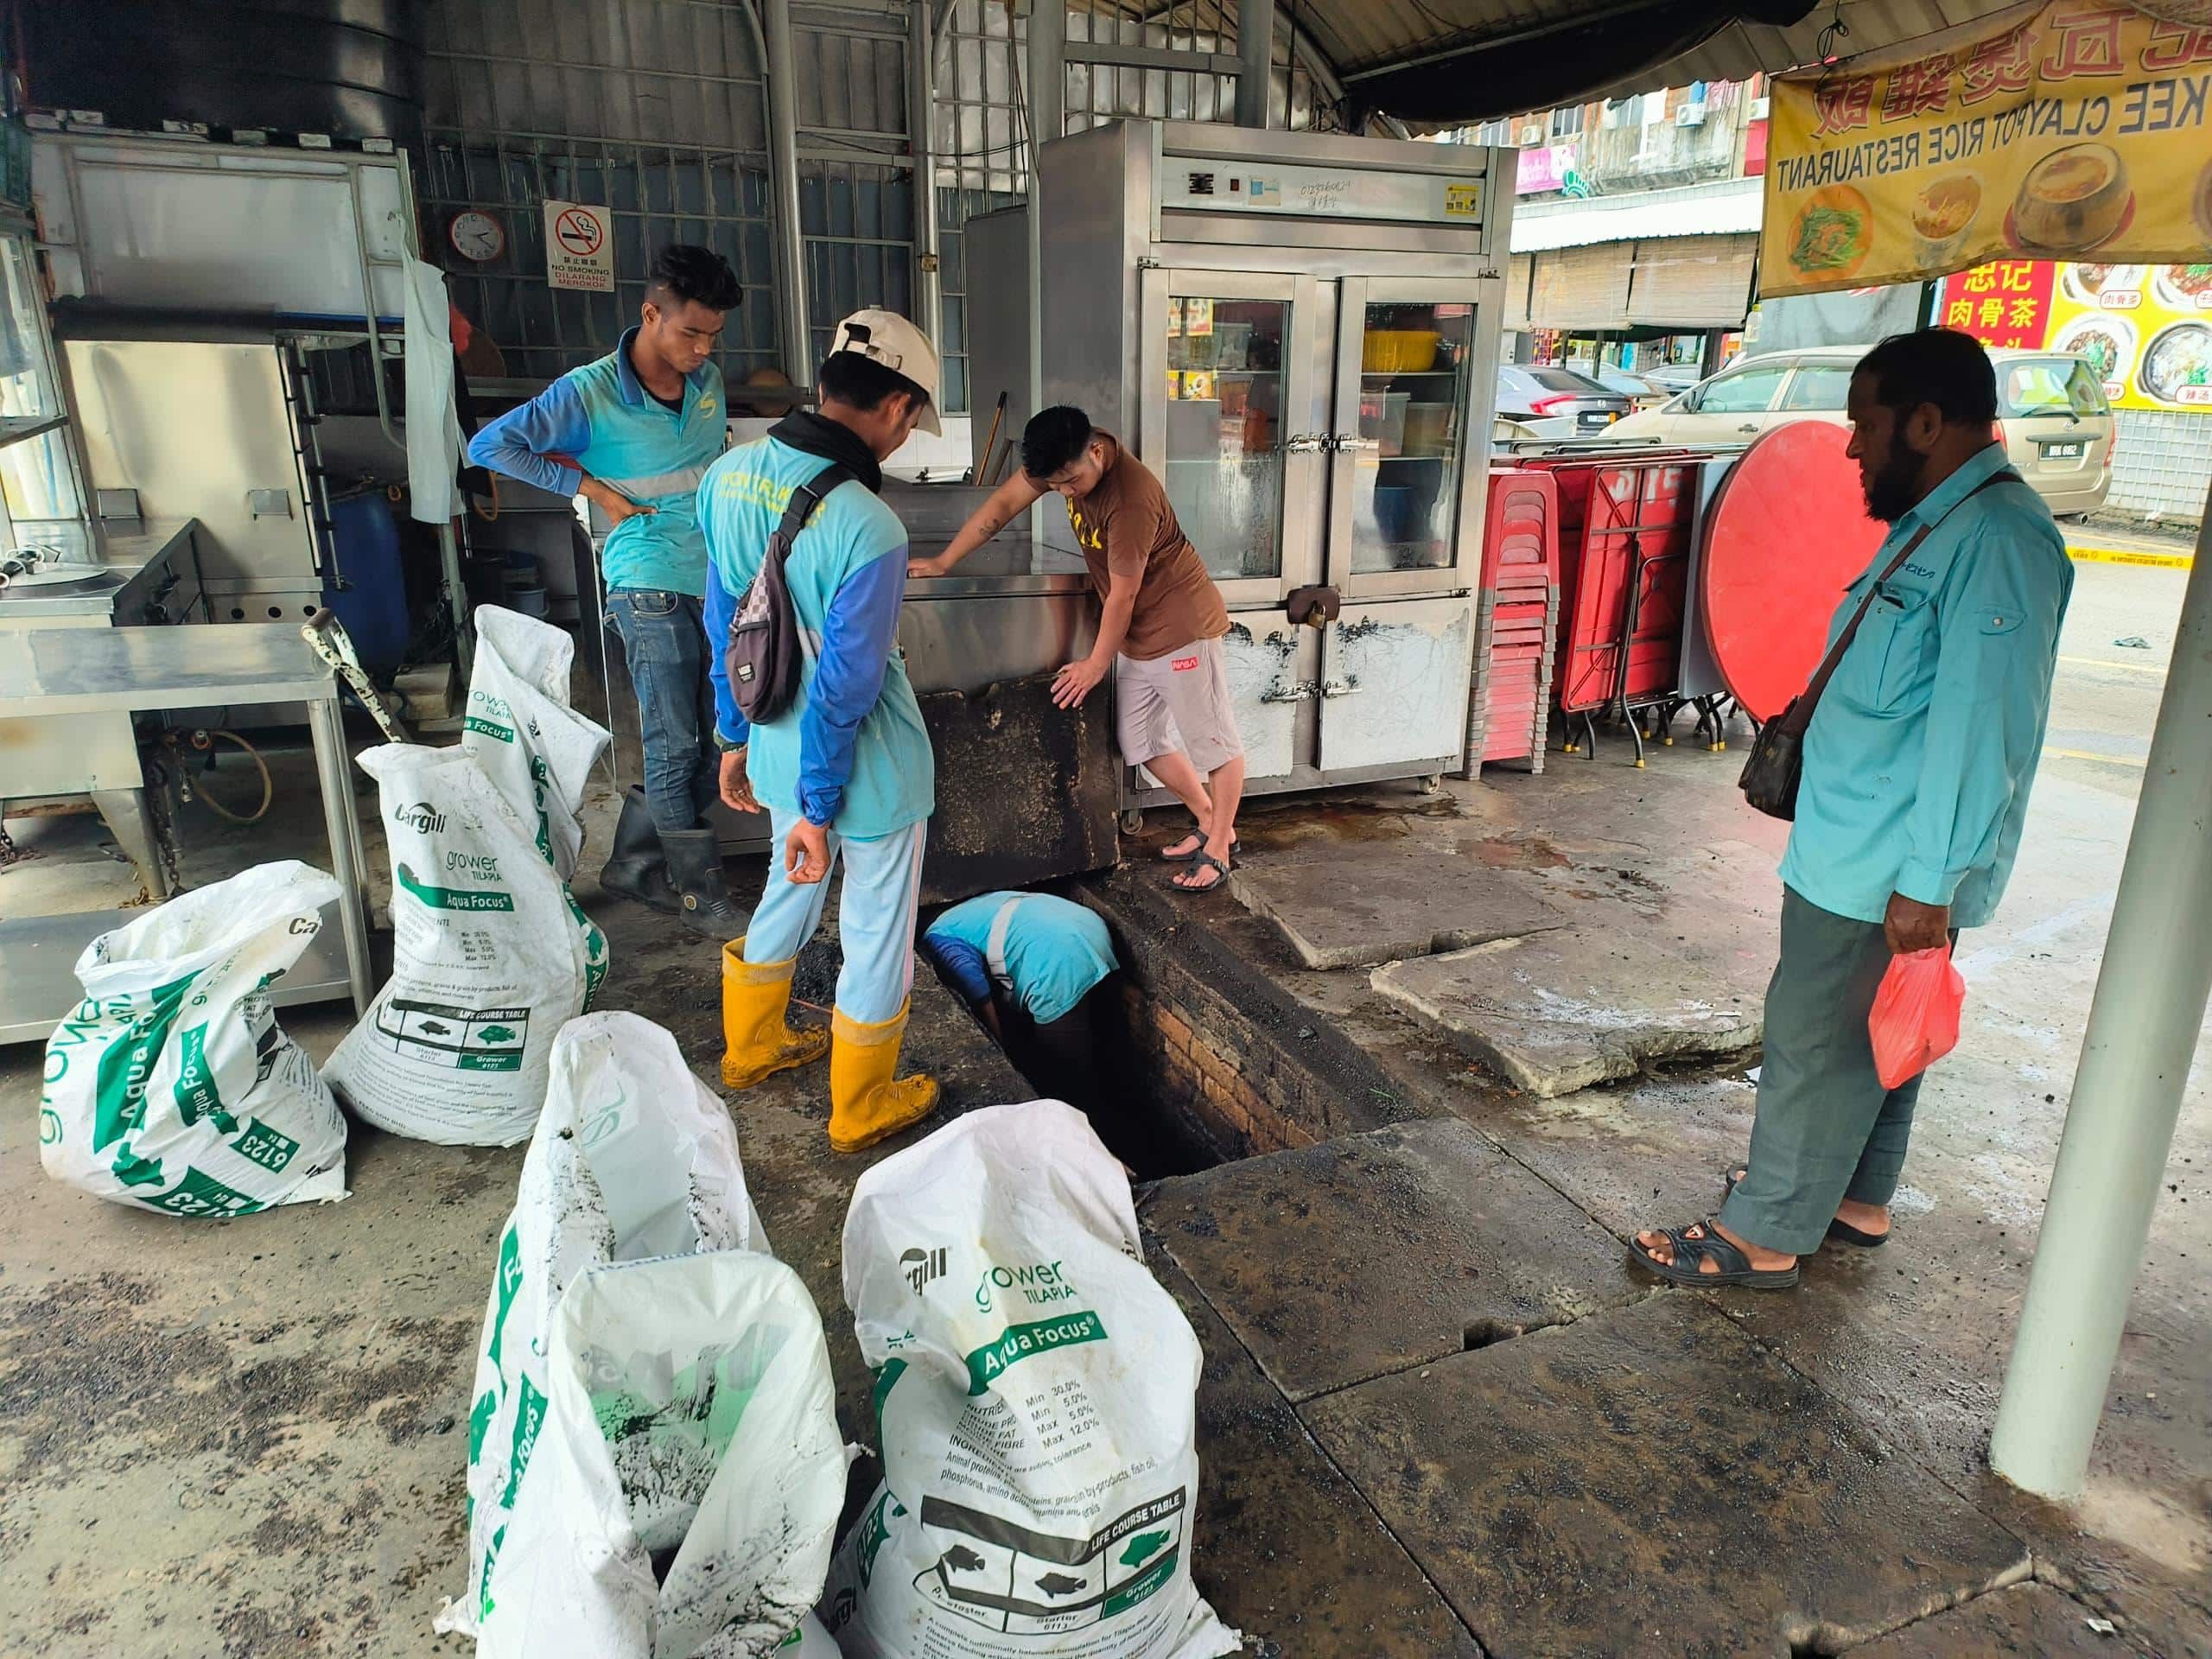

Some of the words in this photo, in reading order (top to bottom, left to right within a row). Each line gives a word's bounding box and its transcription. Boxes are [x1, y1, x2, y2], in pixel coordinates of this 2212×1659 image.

[555, 271, 607, 282] DILARANG
[558, 278, 607, 288] MEROKOK
[568, 266, 609, 276] SMOKING
[1948, 297, 2038, 328] 肉骨茶
[1173, 659, 1197, 670] NASA
[446, 850, 499, 872] grower
[471, 869, 504, 883] TILAPIA
[446, 892, 469, 911] Aqua
[475, 1010, 505, 1020] COURSE
[505, 1009, 525, 1019] TABLE
[120, 1046, 149, 1121] Aqua
[241, 1135, 289, 1173] 6123
[976, 1260, 1063, 1314] gower
[1023, 1285, 1077, 1305] TILAPIA
[982, 1331, 1033, 1376] Aqua
[1026, 1394, 1046, 1408] Min
[1051, 1379, 1081, 1396] 30.0%
[966, 1396, 1005, 1418] NUTRIE
[1031, 1408, 1051, 1422] Min
[1063, 1392, 1088, 1408] 5.0%
[1037, 1420, 1058, 1436] Max
[1069, 1405, 1094, 1421] 5.0%
[1042, 1434, 1065, 1450] Max
[1070, 1418, 1100, 1436] 12.0%
[945, 1451, 971, 1471] Animal
[1130, 1461, 1146, 1476] fish
[986, 1484, 1009, 1500] amino
[1091, 1530, 1111, 1553] LIFE
[1111, 1506, 1150, 1536] COURSE
[1149, 1493, 1181, 1518] TABLE
[1125, 1568, 1162, 1599] Grower
